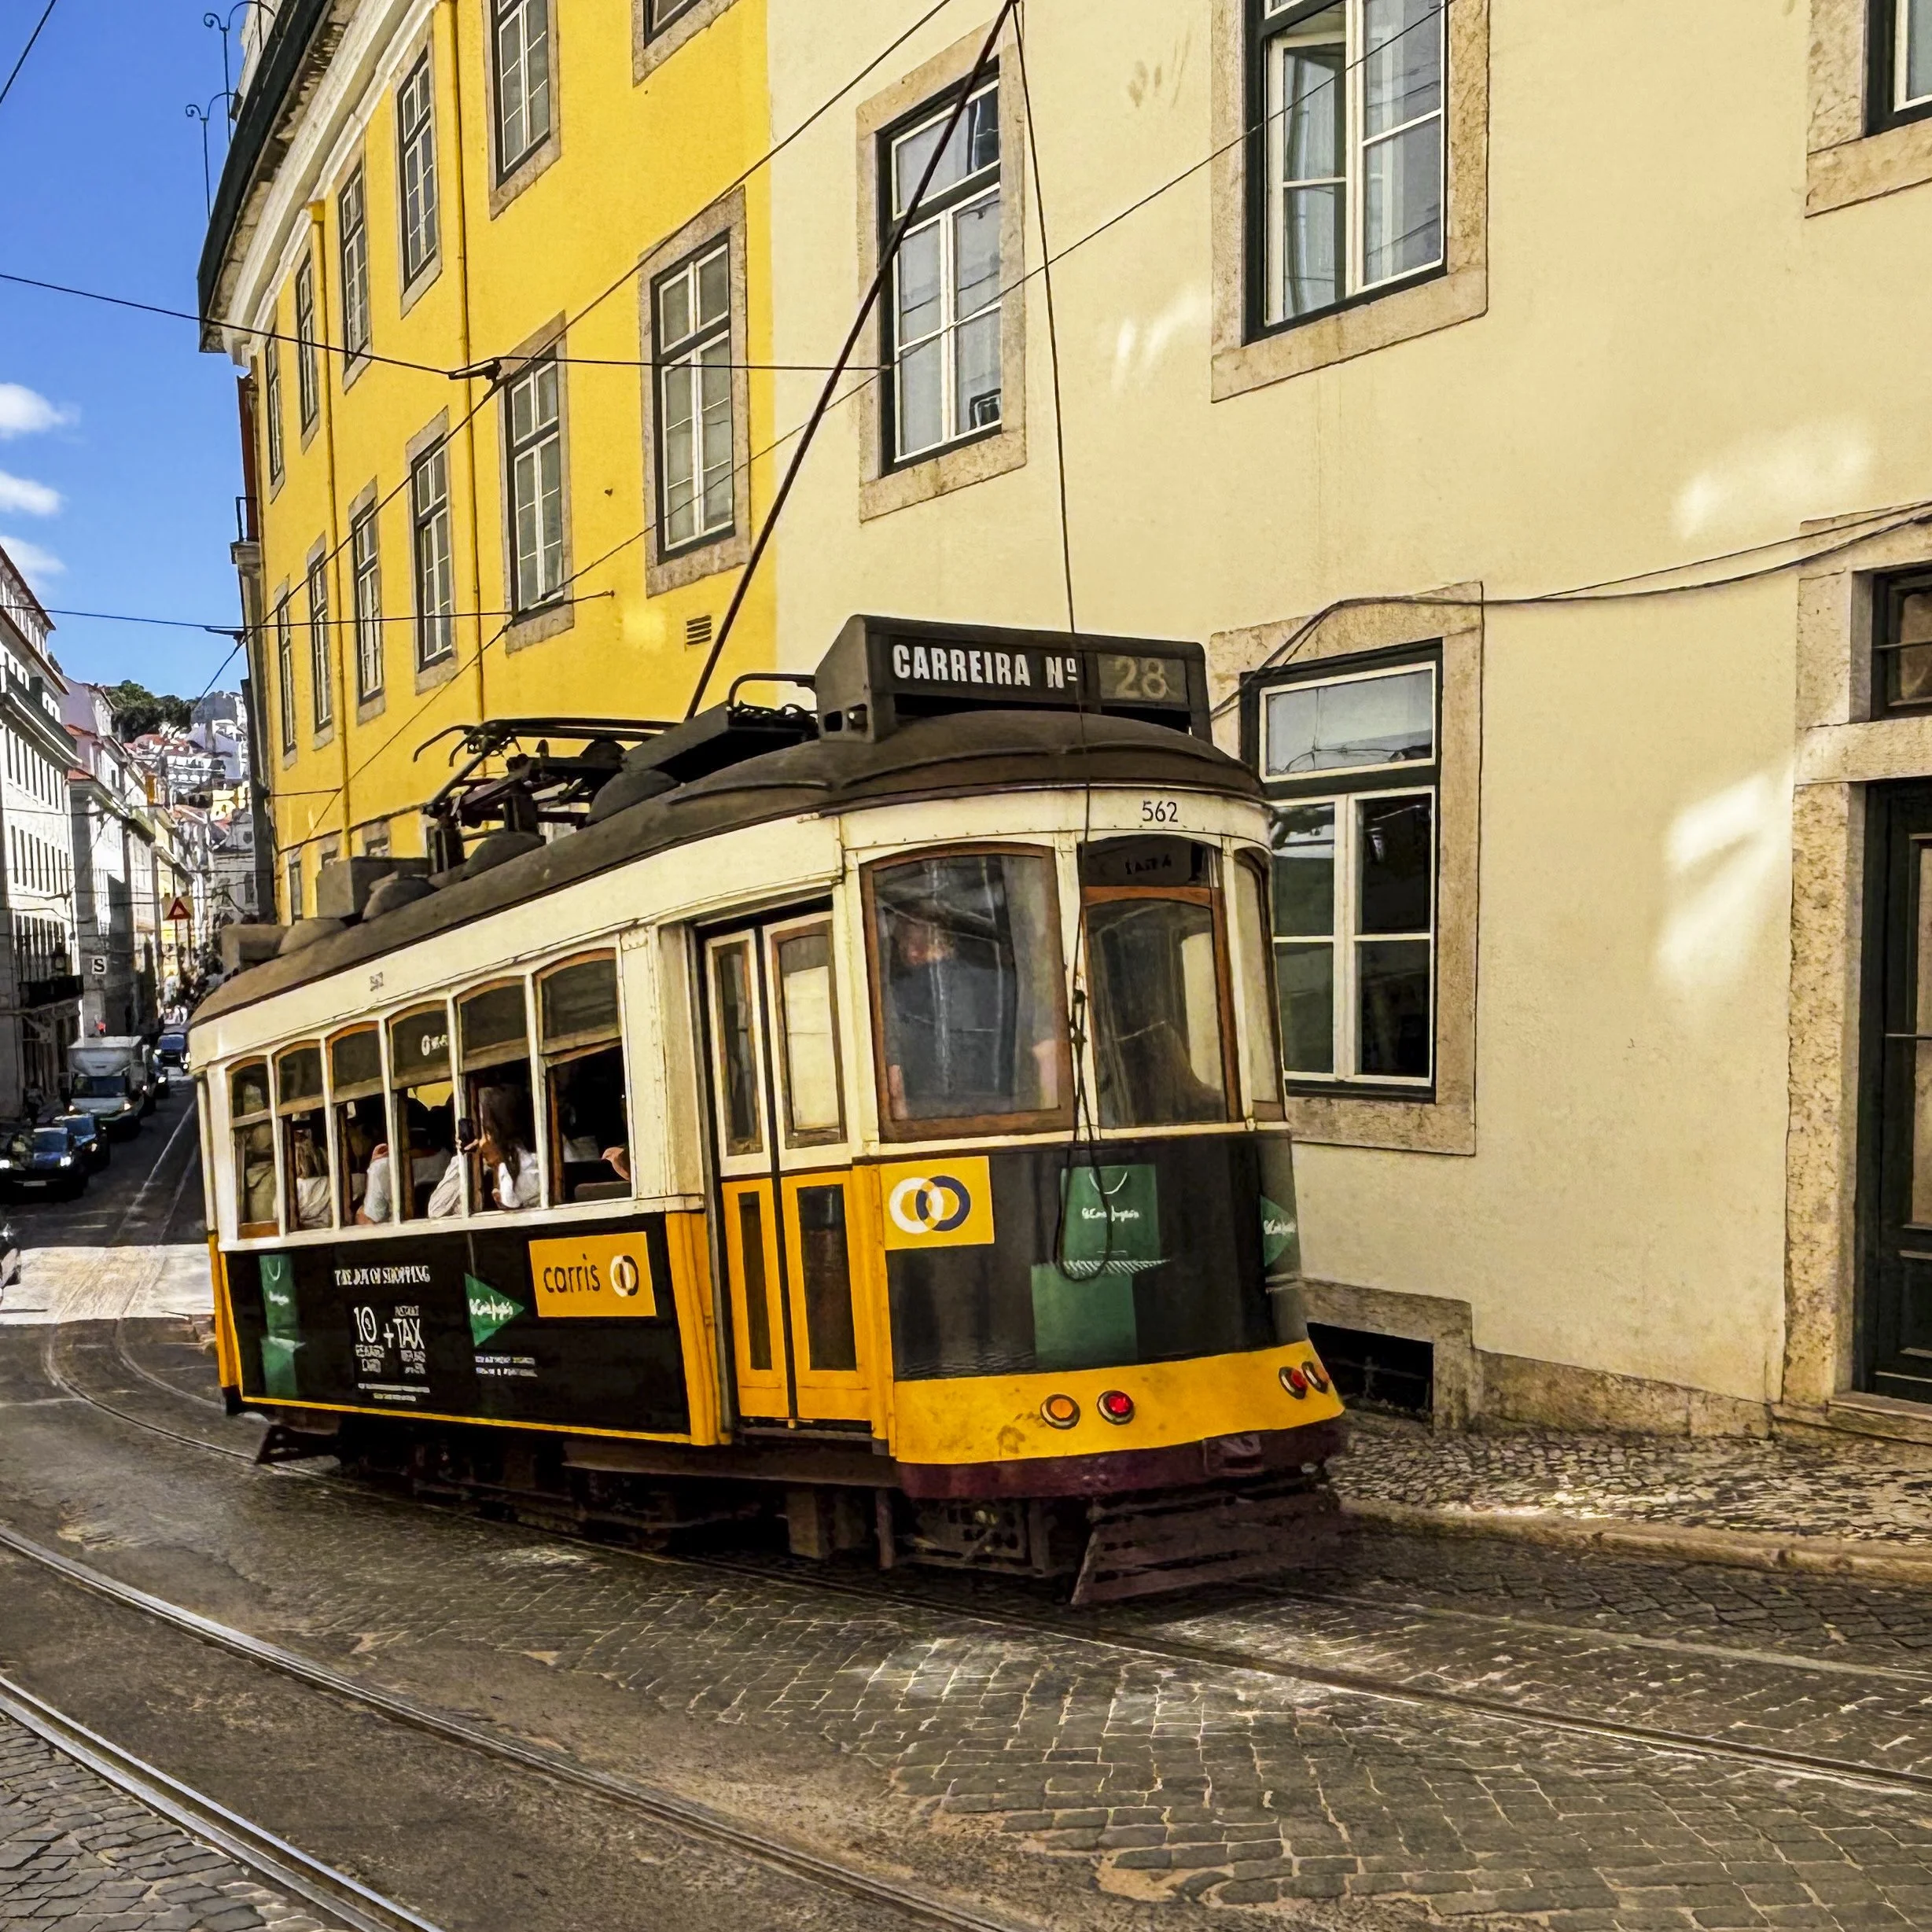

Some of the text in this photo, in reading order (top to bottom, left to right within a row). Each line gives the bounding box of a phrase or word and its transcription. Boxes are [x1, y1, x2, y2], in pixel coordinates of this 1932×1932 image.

[892, 644, 1031, 687] CARREIRA
[1114, 655, 1168, 700] 28
[1141, 800, 1179, 822] 562
[94, 959, 105, 972] S
[543, 1253, 601, 1294] carris
